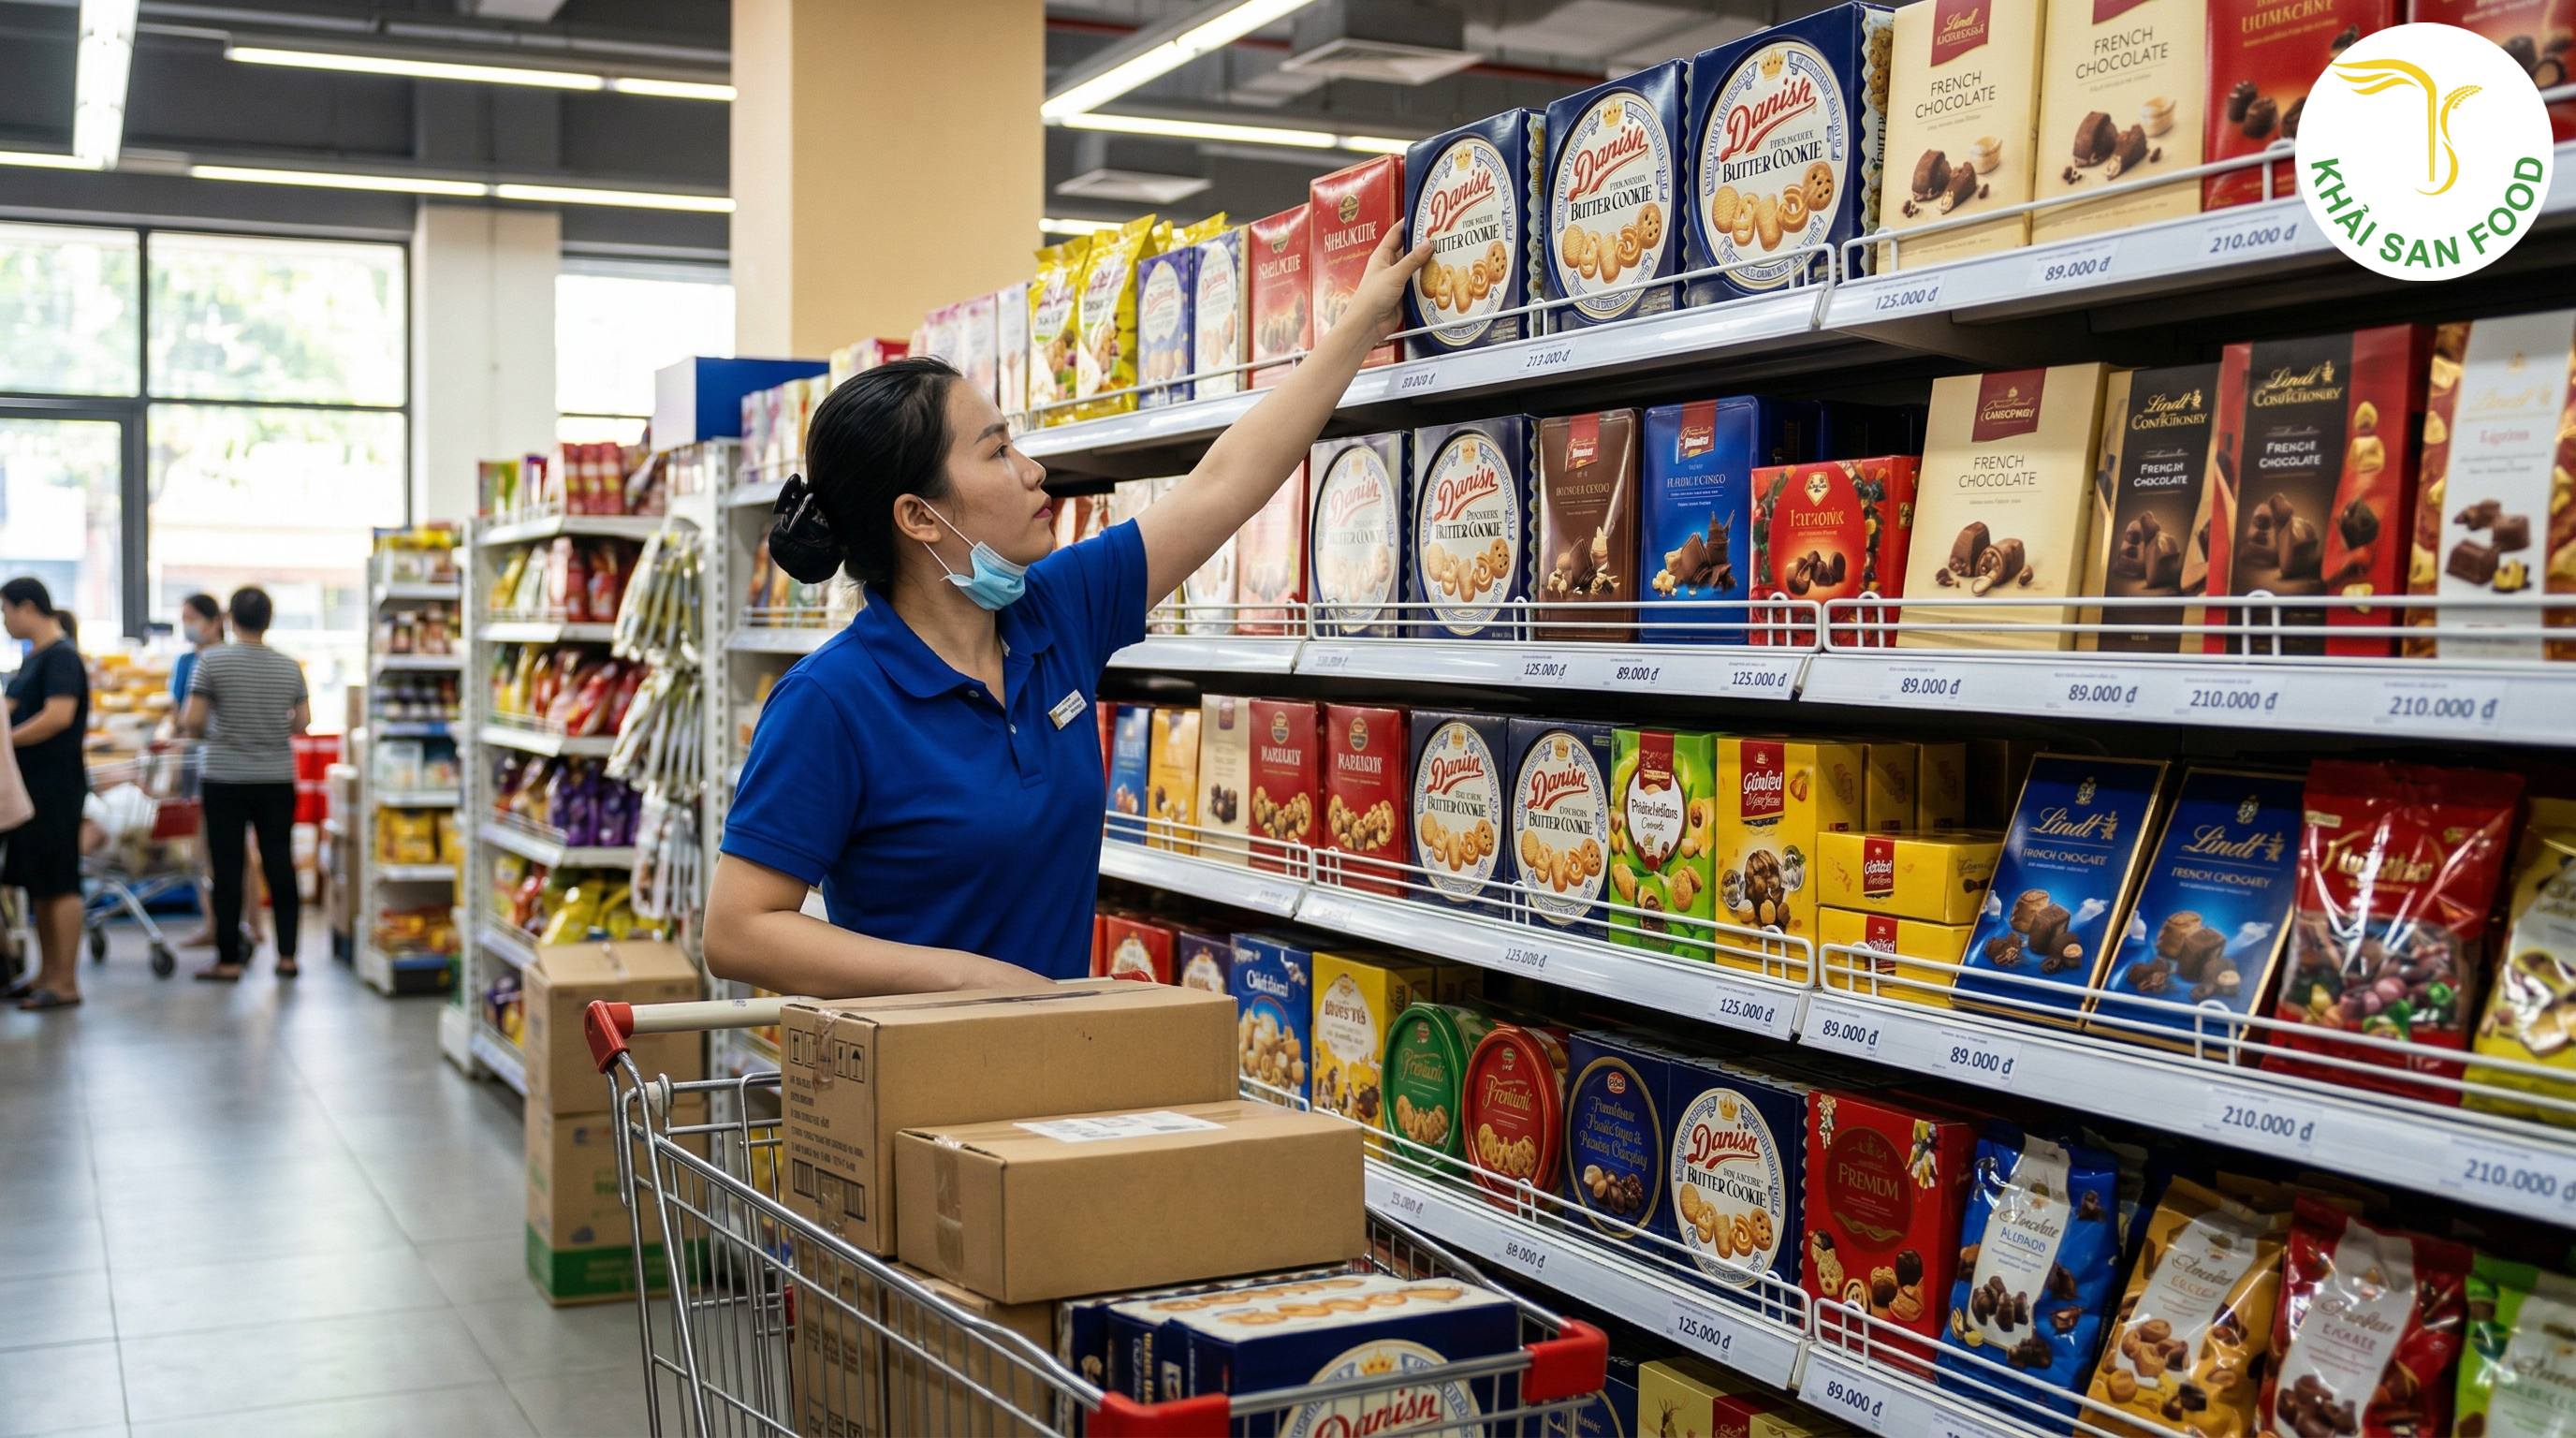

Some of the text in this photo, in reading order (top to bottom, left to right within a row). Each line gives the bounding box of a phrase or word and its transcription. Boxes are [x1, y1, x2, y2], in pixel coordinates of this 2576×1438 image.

[2093, 25, 2154, 56] FRENCH
[2074, 42, 2170, 80] CHOCOLATE
[1930, 70, 1983, 97] FRENCH
[1915, 85, 1997, 119] CHOCOLATE
[1720, 77, 1818, 164] Danish
[1569, 125, 1649, 203] Danish
[1722, 140, 1823, 183] BUTTER COOKIE
[1425, 169, 1496, 238] Danish
[1570, 184, 1654, 223] BUTTER COOKIE
[1465, 224, 1500, 250] COOKIE
[2209, 223, 2298, 255] 210.000 đ
[2044, 256, 2112, 282] 89.000 đ
[1874, 286, 1939, 312] 125.000 đ
[1974, 455, 2025, 471] FRENCH
[1433, 464, 1499, 522] Danish
[1958, 472, 2038, 489] CHOCOLATE
[1326, 477, 1381, 530] Danish
[1524, 662, 1568, 677] 125.000 đ
[1617, 667, 1661, 682] 89.000 đ
[1732, 671, 1788, 687] 125.000 đ
[1901, 678, 1962, 696] 89.000 đ
[2068, 684, 2140, 703] 89.000 đ
[2189, 689, 2279, 711] 210.000 đ
[2388, 696, 2498, 720] 210.000 đ
[1528, 810, 1560, 830] BUTTER
[2027, 807, 2104, 839] Lindt
[2180, 824, 2269, 860] Lindt
[1720, 998, 1775, 1023] 125.000 đ
[1822, 1019, 1880, 1047] 89.000 đ
[1950, 1046, 2014, 1076] 89.000 đ
[2221, 1105, 2315, 1142] 210.000 đ
[2464, 1157, 2558, 1198] 210.000
[1726, 1179, 1767, 1209] COOKIE
[1678, 1315, 1732, 1350] 125.000 đ
[1826, 1381, 1883, 1418] 89.000 đ
